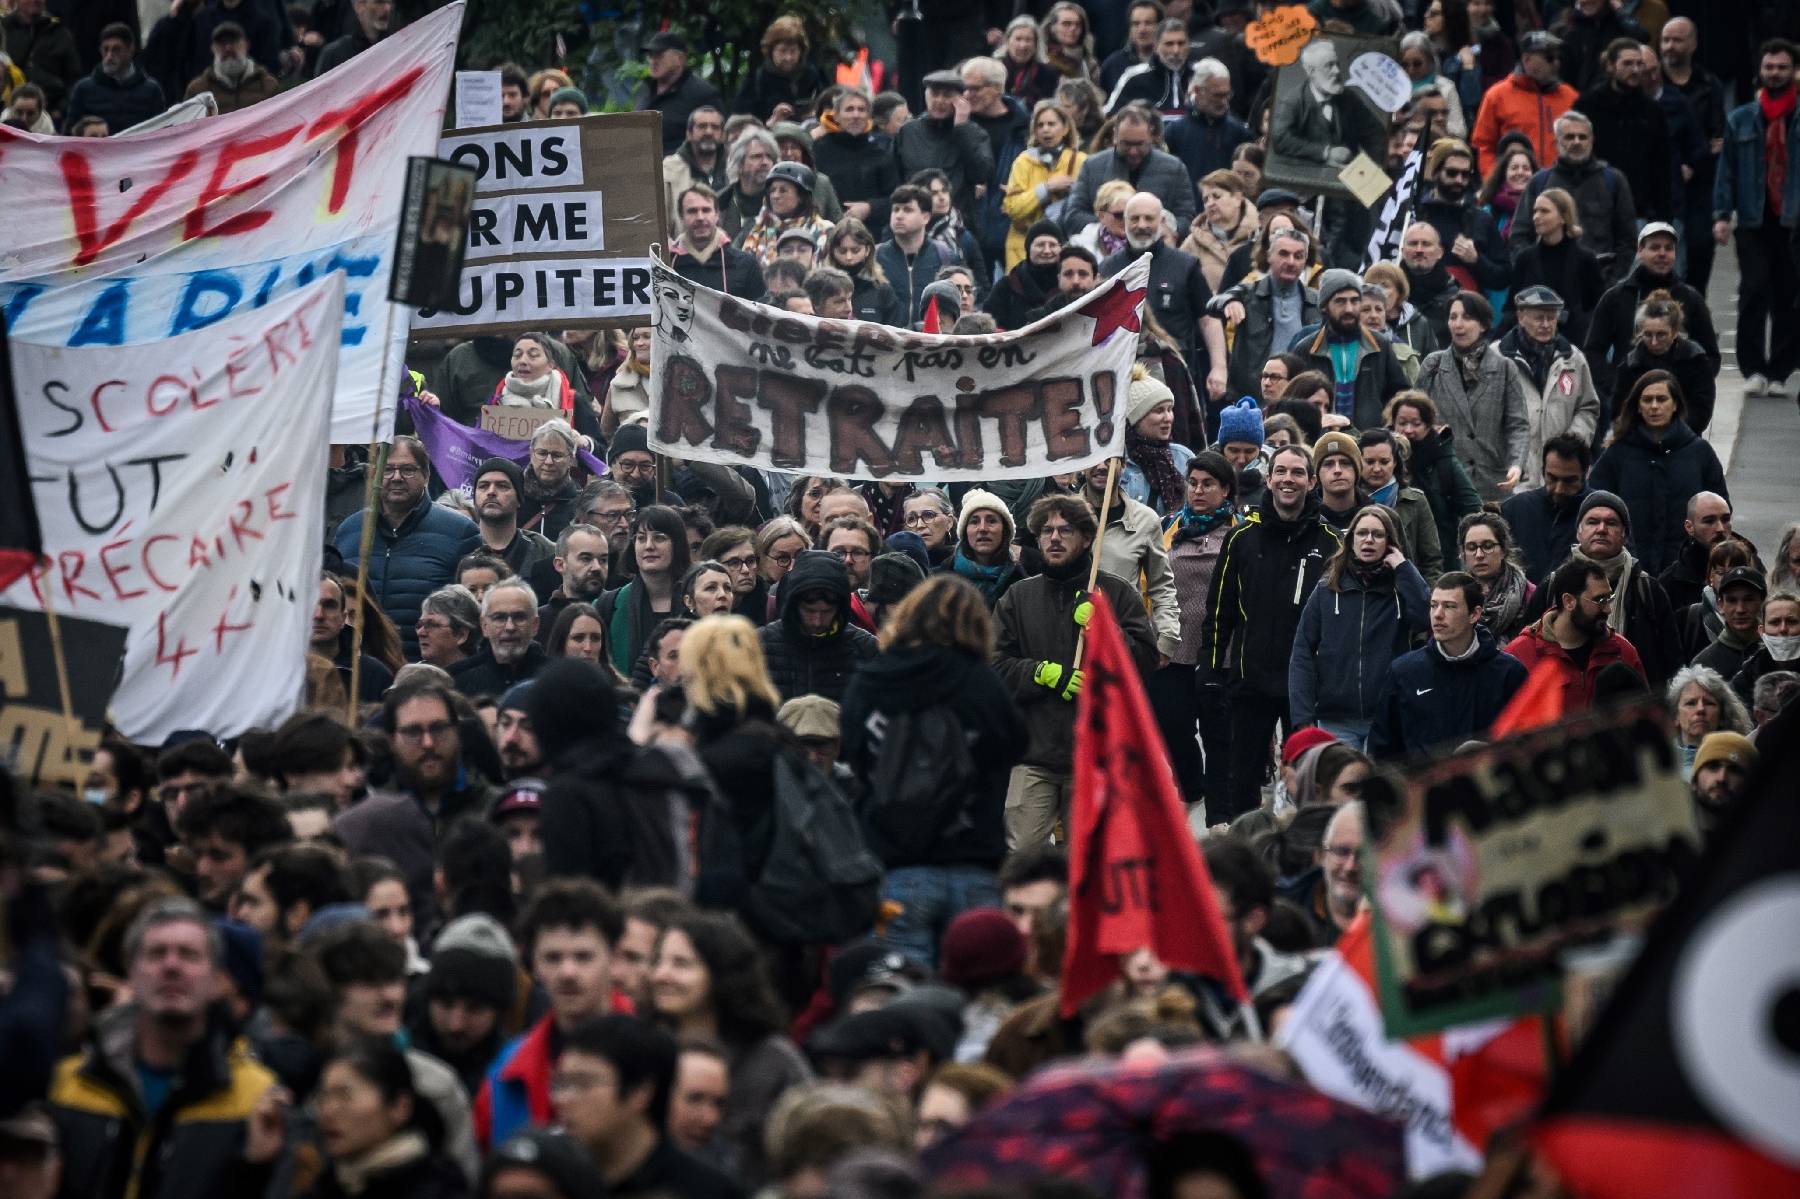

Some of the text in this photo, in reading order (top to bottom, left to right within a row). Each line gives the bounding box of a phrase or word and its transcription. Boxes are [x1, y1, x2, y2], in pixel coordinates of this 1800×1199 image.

[0, 66, 425, 266] VET
[451, 137, 568, 181] ONS
[470, 203, 588, 247] RME
[750, 342, 1037, 382] ne bat pas en
[487, 416, 545, 437] REFOR
[30, 452, 191, 535] UT
[28, 482, 297, 609] PRÉCAIRE
